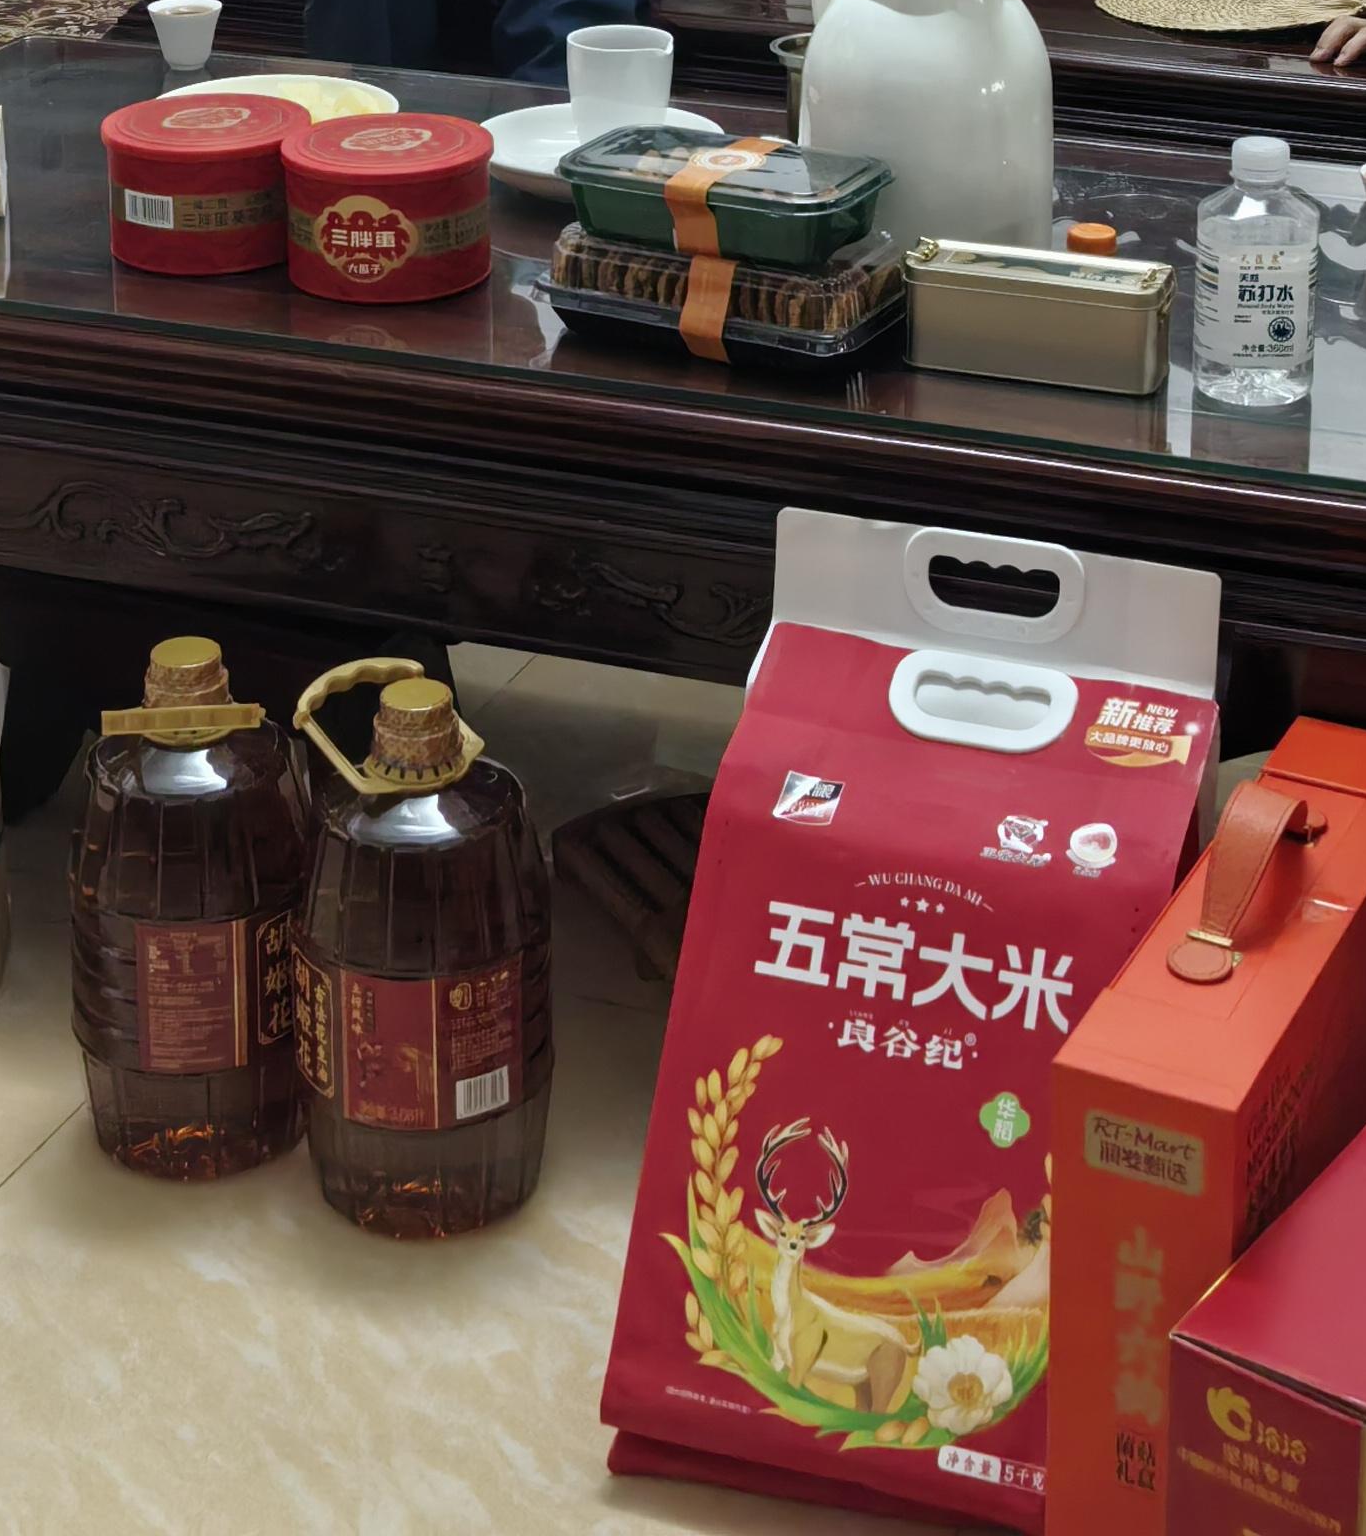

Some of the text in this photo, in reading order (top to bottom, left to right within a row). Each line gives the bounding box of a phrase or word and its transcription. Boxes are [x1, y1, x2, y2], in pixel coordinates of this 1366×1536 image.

[331, 228, 396, 249] 三胖蛋
[1238, 284, 1294, 302] 苏打水
[1146, 703, 1179, 719] NEW
[1089, 730, 1169, 754] 大品牌更放心
[868, 872, 983, 906] WU CHANG DA MI
[754, 900, 1074, 1034] 五常大米
[837, 1018, 963, 1070] 良谷纪
[1093, 1116, 1197, 1161] RT-Mart
[945, 1450, 1045, 1491] 净含量 5千克
